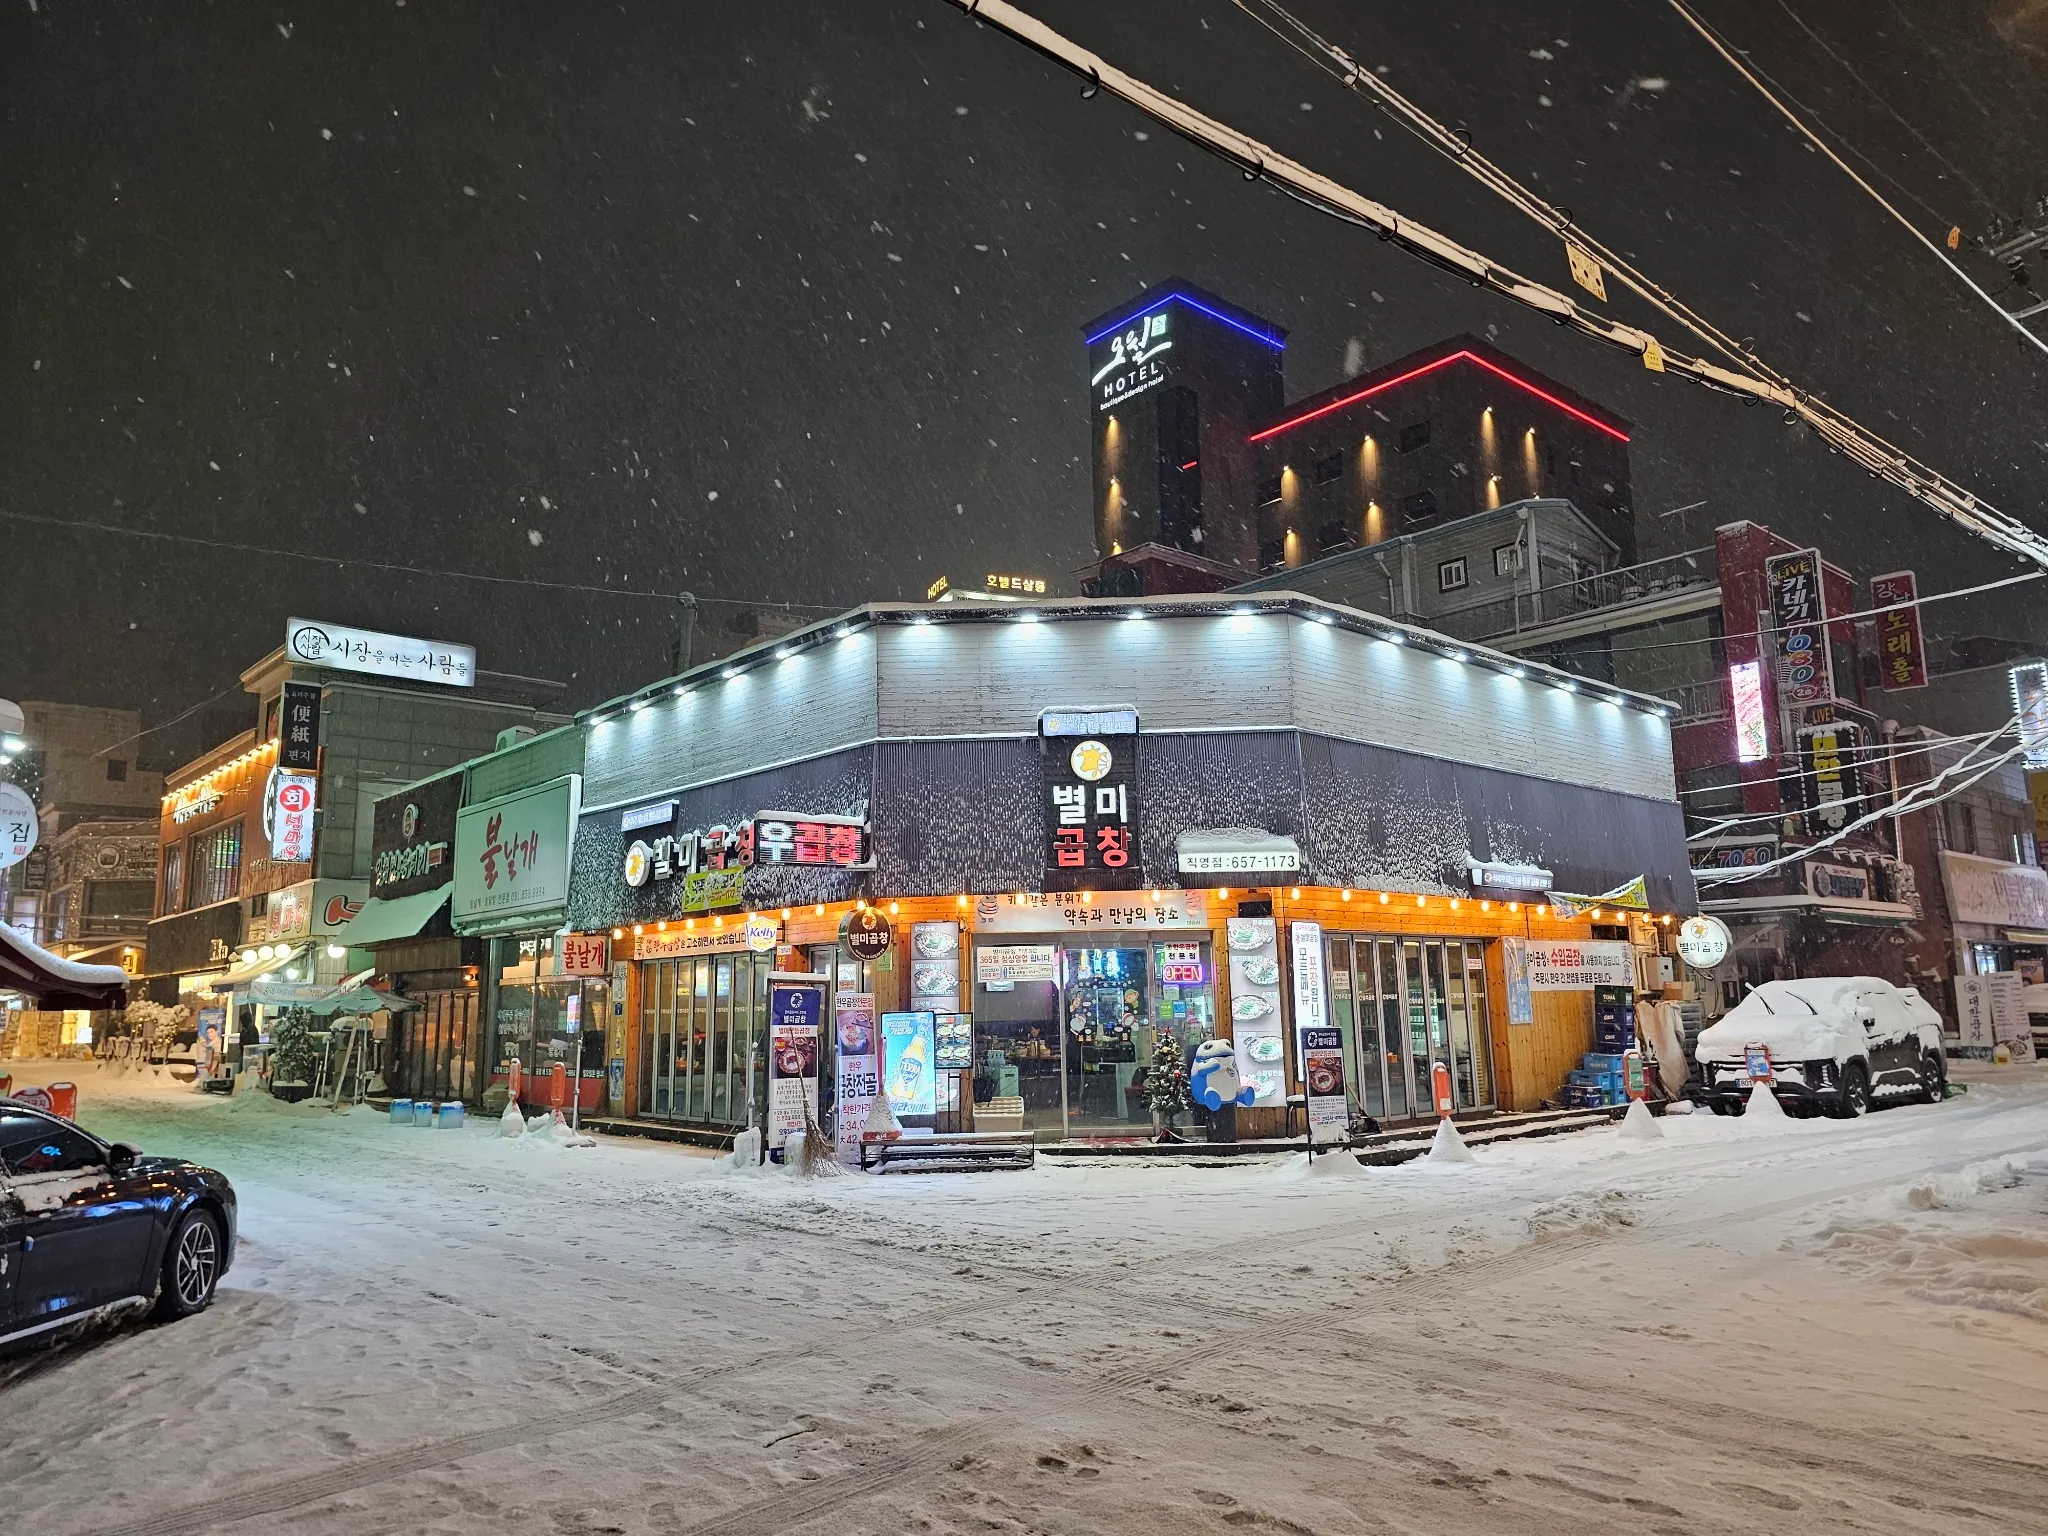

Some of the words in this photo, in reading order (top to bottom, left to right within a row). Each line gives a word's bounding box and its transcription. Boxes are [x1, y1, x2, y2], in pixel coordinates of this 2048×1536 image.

[1105, 362, 1158, 397] HOTEL
[1777, 560, 1811, 580] LIVE
[927, 576, 948, 600] HOTEL
[986, 575, 1045, 593] 호텔드살롱
[1781, 575, 1809, 620] 카네기
[332, 637, 385, 665] 시장을
[417, 651, 468, 677] 사람들
[1786, 618, 1815, 684] 7080
[1884, 611, 1915, 683] 노래홀
[1812, 707, 1831, 723] LIVE
[288, 749, 311, 763] 편지
[284, 789, 304, 810] 회
[1053, 784, 1128, 825] 별미
[480, 812, 539, 889] 불날개
[653, 825, 755, 881] 별미곱창
[760, 822, 862, 863] 우곱창
[1053, 826, 1132, 867] 곱창
[1717, 847, 1771, 868] 7080
[1007, 894, 1049, 907] 카같은
[1064, 908, 1103, 926] 약속과
[1109, 908, 1147, 925] 만남의
[1154, 907, 1180, 924] 장소
[750, 927, 776, 940] Kelly
[850, 932, 888, 946] 별미곱창
[563, 940, 604, 970] 불날개
[1679, 941, 1724, 954] 별미곱창
[980, 955, 1000, 964] 365일
[1002, 954, 1028, 964] 정상영업
[1164, 965, 1200, 981] OPEN
